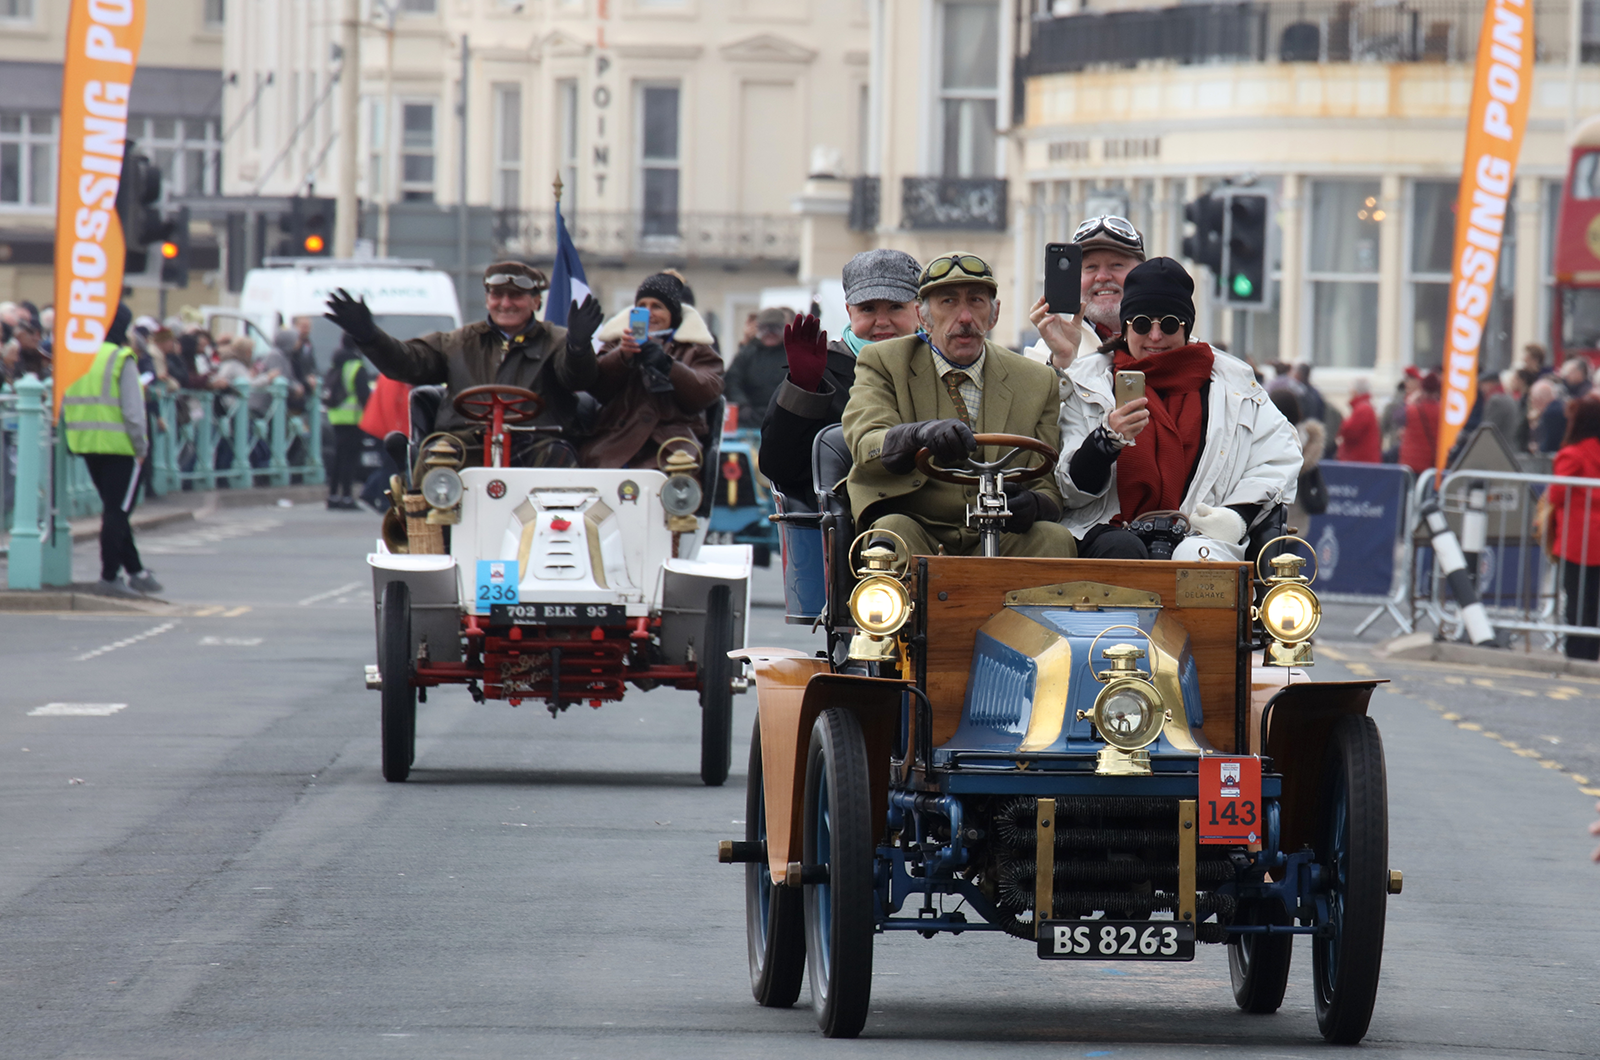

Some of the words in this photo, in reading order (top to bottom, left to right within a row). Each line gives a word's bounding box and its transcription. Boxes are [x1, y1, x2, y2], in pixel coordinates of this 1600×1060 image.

[593, 56, 611, 197] POINT
[65, 79, 130, 355] CROSSING
[479, 585, 516, 601] 236
[1184, 591, 1225, 599] DELAHAYE
[506, 606, 536, 618] 702
[543, 606, 577, 617] ELK
[586, 606, 608, 618] 95
[1208, 800, 1257, 826] 143
[1053, 926, 1091, 954] BS
[1098, 926, 1178, 955] 8263
